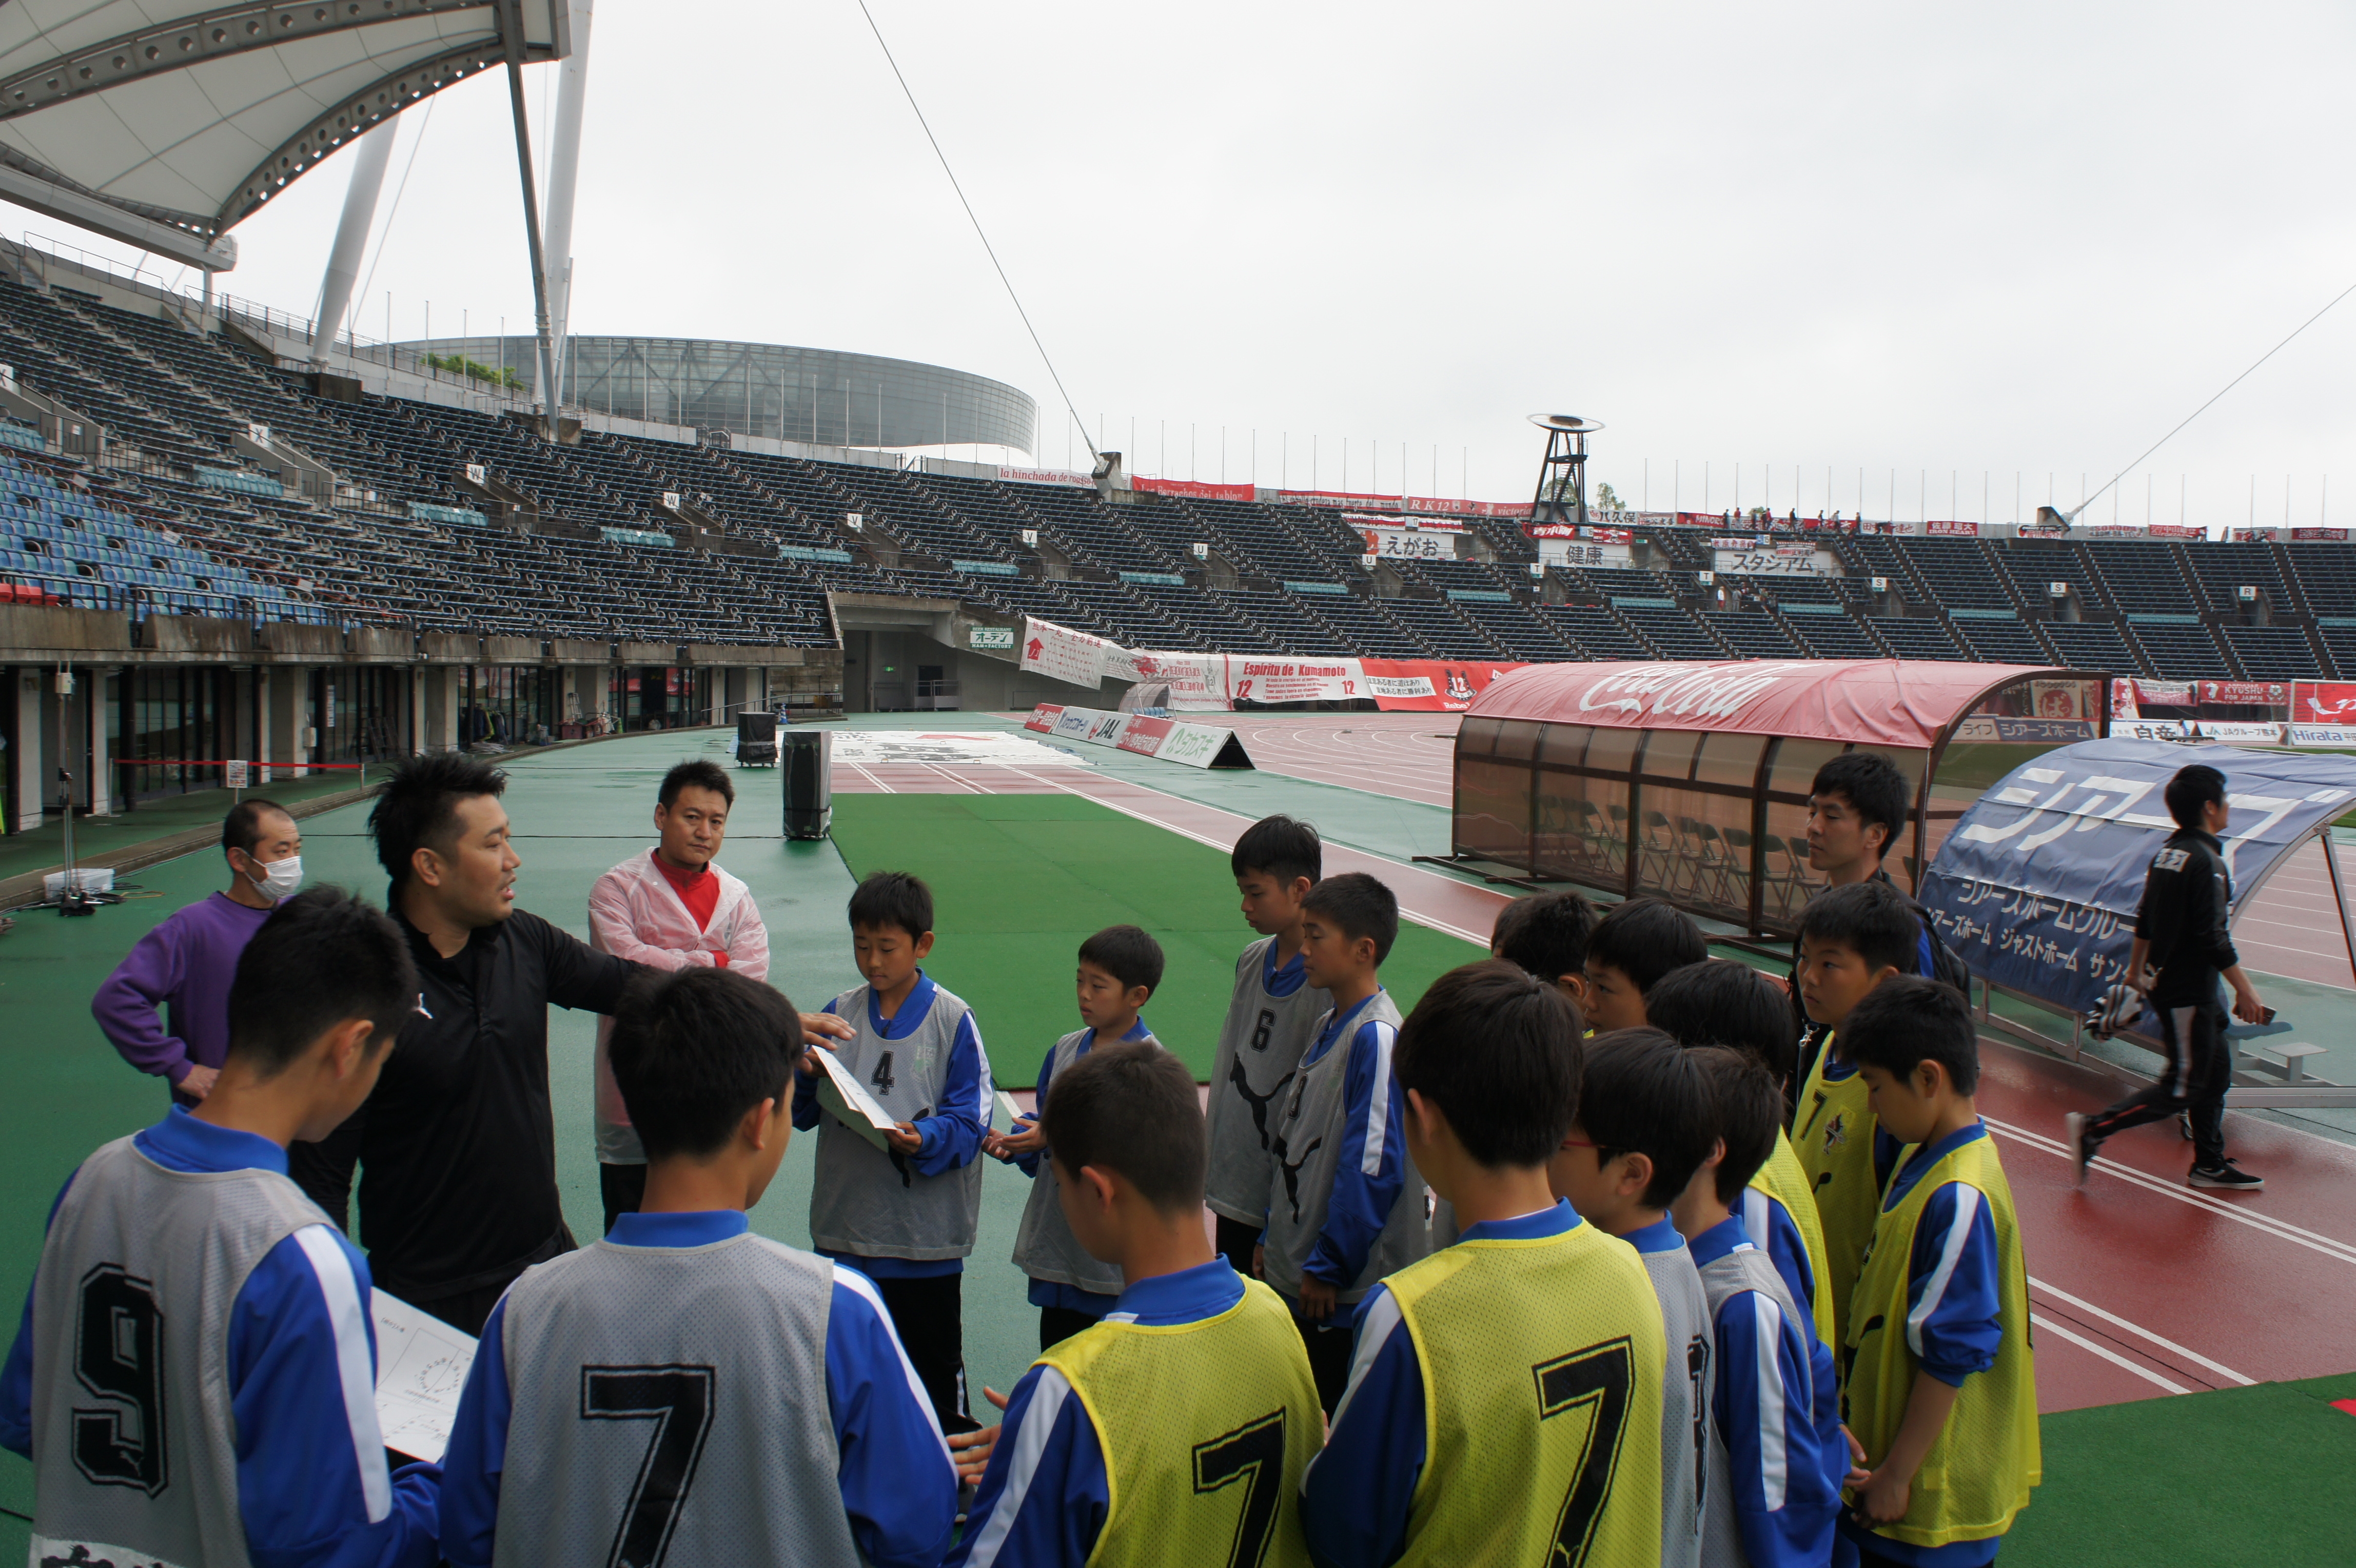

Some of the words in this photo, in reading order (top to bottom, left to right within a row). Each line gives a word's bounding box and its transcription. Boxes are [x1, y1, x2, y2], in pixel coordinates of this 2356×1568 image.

[468, 466, 481, 480] W
[1000, 468, 1009, 478] la
[1012, 469, 1056, 481] hinchada
[1058, 473, 1067, 481] de
[667, 494, 676, 505] W
[1498, 506, 1532, 516] victoria
[852, 516, 858, 525] V
[1412, 518, 1418, 526] 17
[1027, 532, 1033, 541] V
[1197, 545, 1204, 554] U
[1385, 536, 1439, 556] えがお
[1366, 556, 1372, 564] U
[1566, 545, 1603, 565] 健康
[1733, 554, 1813, 572] スタジアム
[976, 633, 1009, 642] オーデン
[1243, 662, 1281, 676] Espíritu
[1282, 664, 1294, 676] de
[1298, 664, 1346, 677] Kumamoto
[1236, 680, 1253, 697] 12
[1342, 680, 1356, 695] 12
[1451, 677, 1465, 691] 12
[2225, 687, 2263, 695] KYUSHU
[1095, 718, 1121, 739] JAL
[2000, 723, 2091, 737] シアーズホーム
[2294, 730, 2343, 741] Hirata
[1174, 731, 1218, 759] タカスギ
[2000, 928, 2078, 972] ジャストホーム
[2090, 953, 2131, 982] サン
[1250, 1008, 1277, 1053] 6
[871, 1051, 895, 1095] 4
[71, 1261, 168, 1500] 9
[1531, 1335, 1636, 1568] 7
[580, 1363, 716, 1568] 7
[1191, 1405, 1287, 1568] 7
